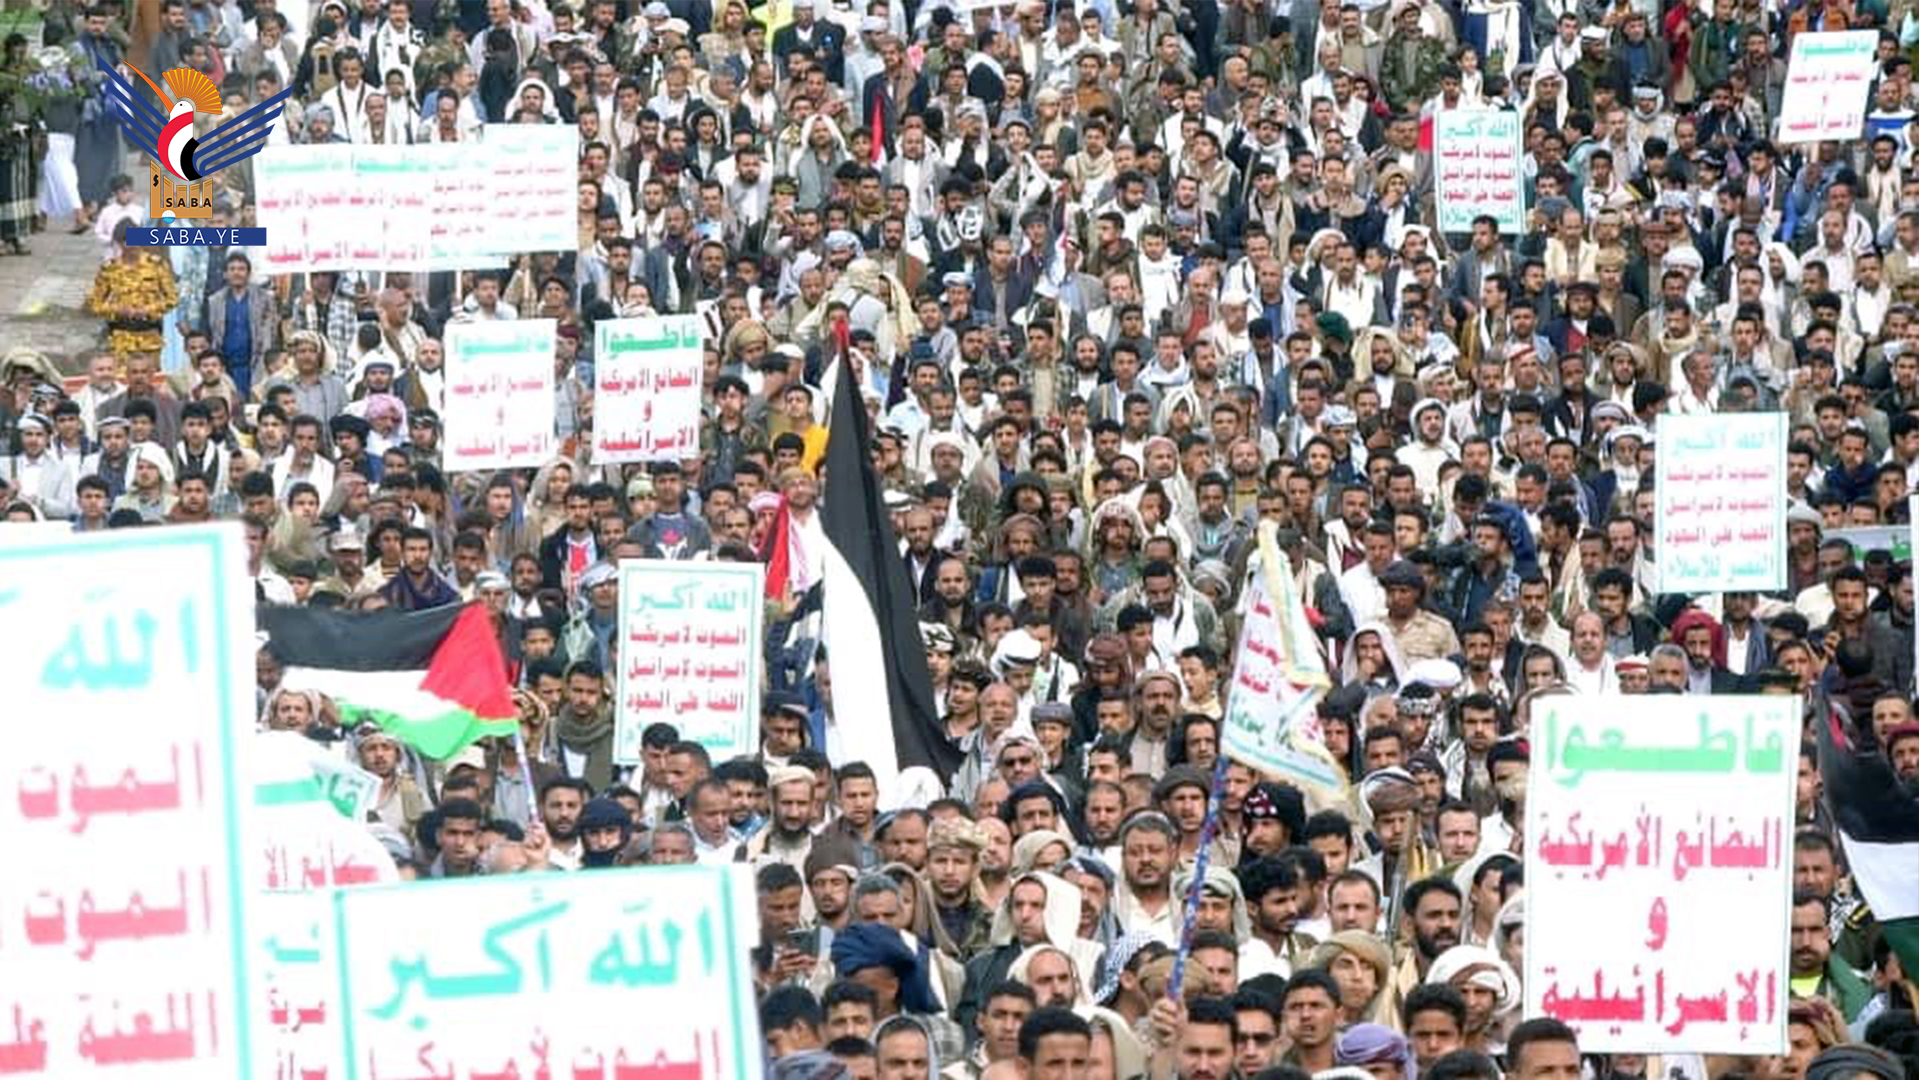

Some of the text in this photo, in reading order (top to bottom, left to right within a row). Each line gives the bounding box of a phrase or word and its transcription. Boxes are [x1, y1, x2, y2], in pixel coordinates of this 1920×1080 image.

[602, 321, 699, 359] قاطعوا
[643, 400, 652, 422] و
[696, 624, 747, 649] الموت
[704, 583, 749, 613] الله
[40, 586, 198, 690] الله
[695, 658, 746, 683] الموت
[17, 740, 205, 835] الموت
[1545, 710, 1785, 789] قاطعوا
[1539, 803, 1782, 881] البضائع الأمريكية
[24, 864, 212, 961] الموت
[588, 898, 716, 988] الله
[1645, 896, 1668, 951] و
[365, 888, 570, 1031] أكبر
[0, 1001, 46, 1076] عل
[78, 988, 218, 1066] اللعنة
[1542, 964, 1777, 1041] الإسرائيلية
